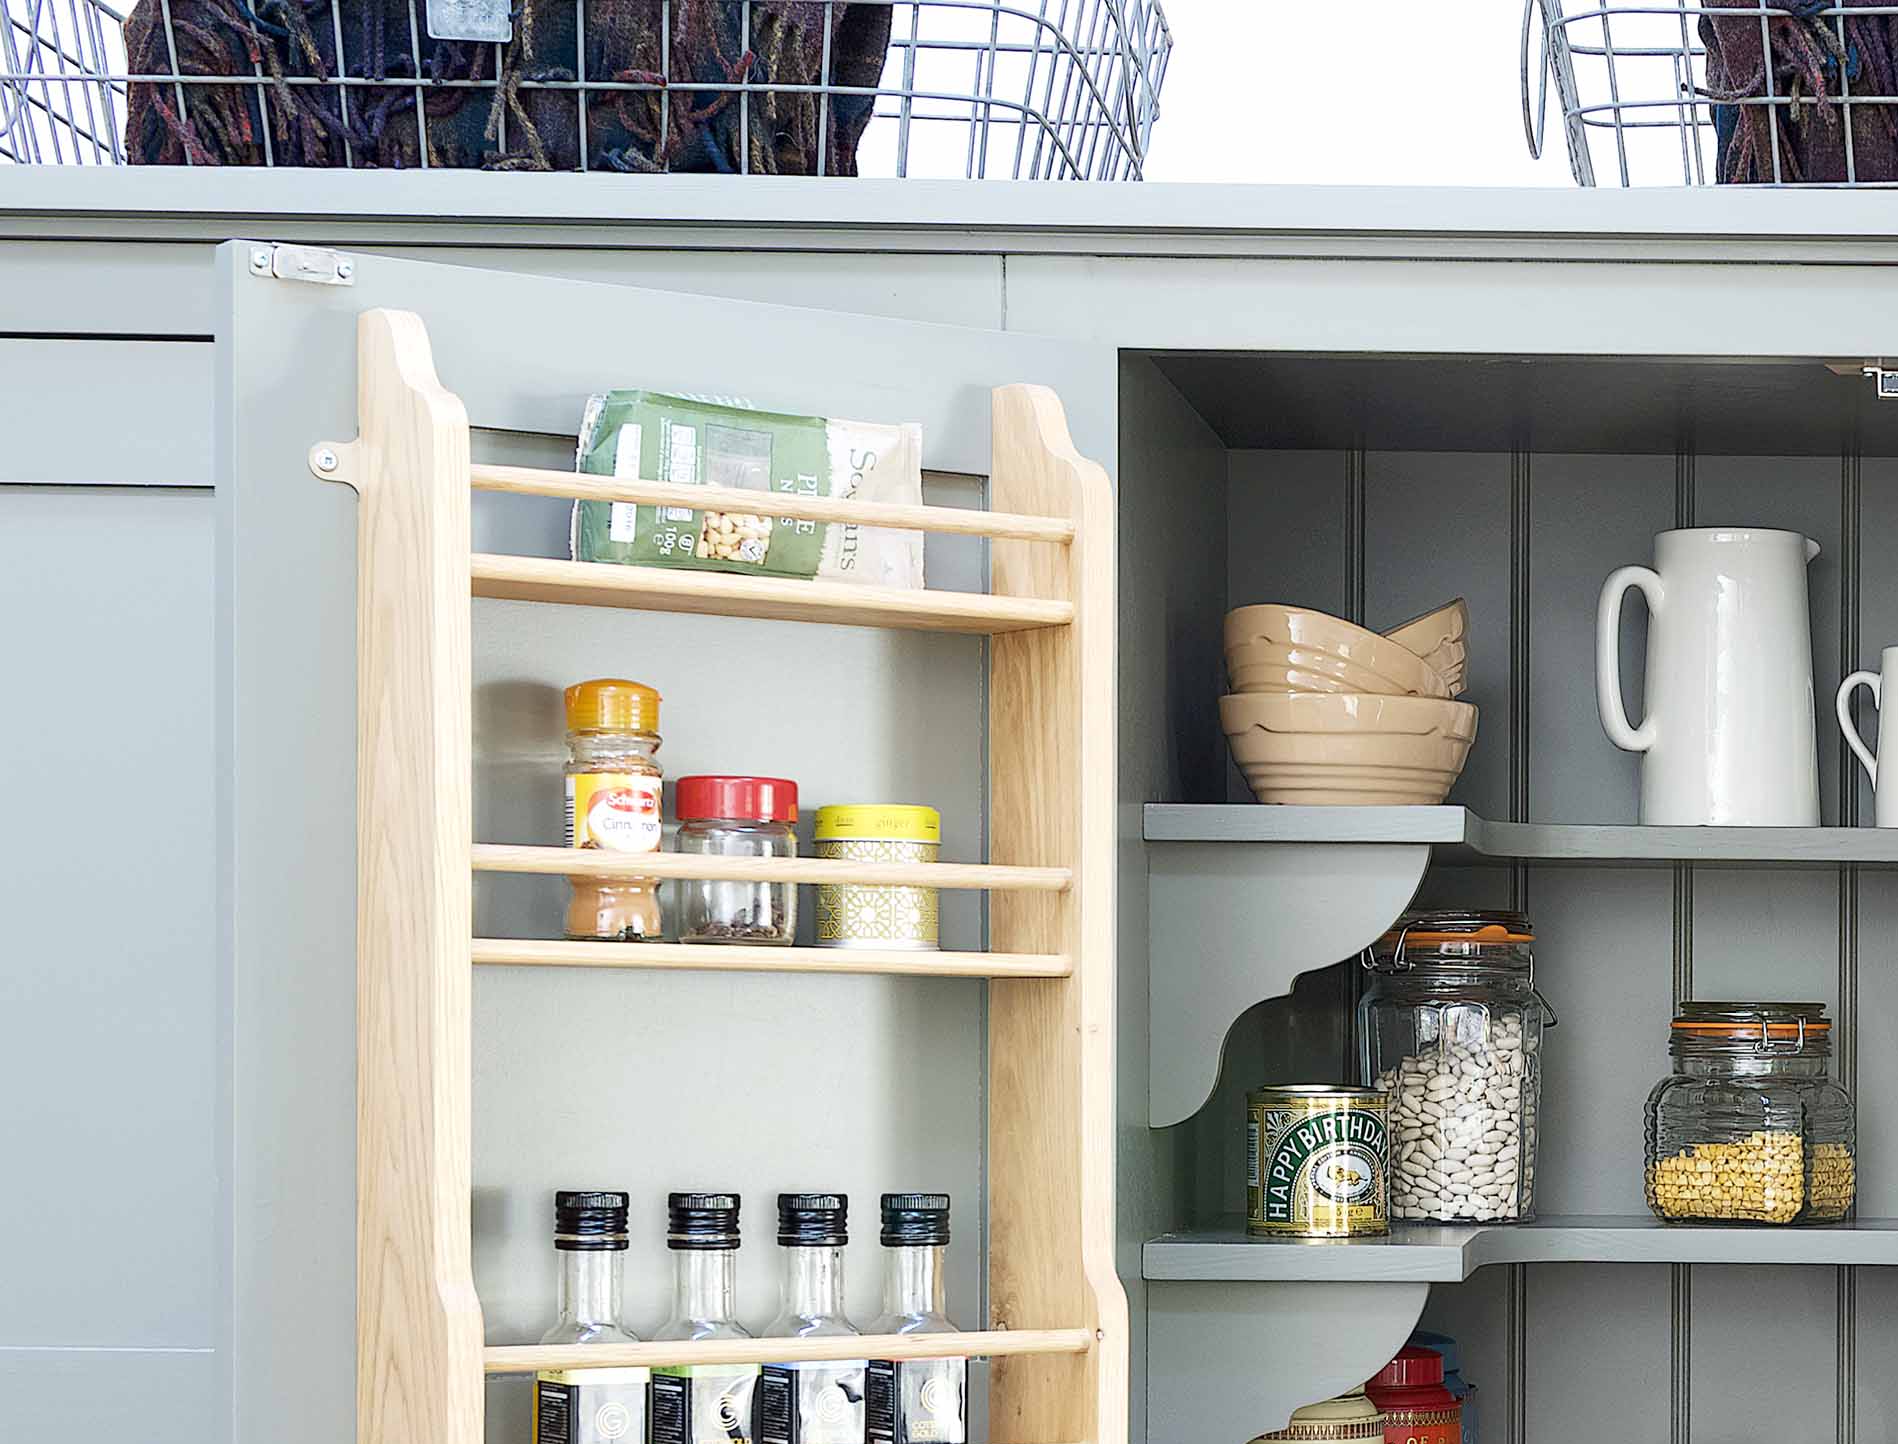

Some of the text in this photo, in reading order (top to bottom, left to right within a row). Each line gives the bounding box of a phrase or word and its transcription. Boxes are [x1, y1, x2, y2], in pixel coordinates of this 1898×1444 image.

[797, 472, 818, 534] PIE
[659, 526, 677, 555] 100g
[1269, 1137, 1302, 1219] HAPPY
[1297, 1115, 1388, 1158] BIRTHDAY
